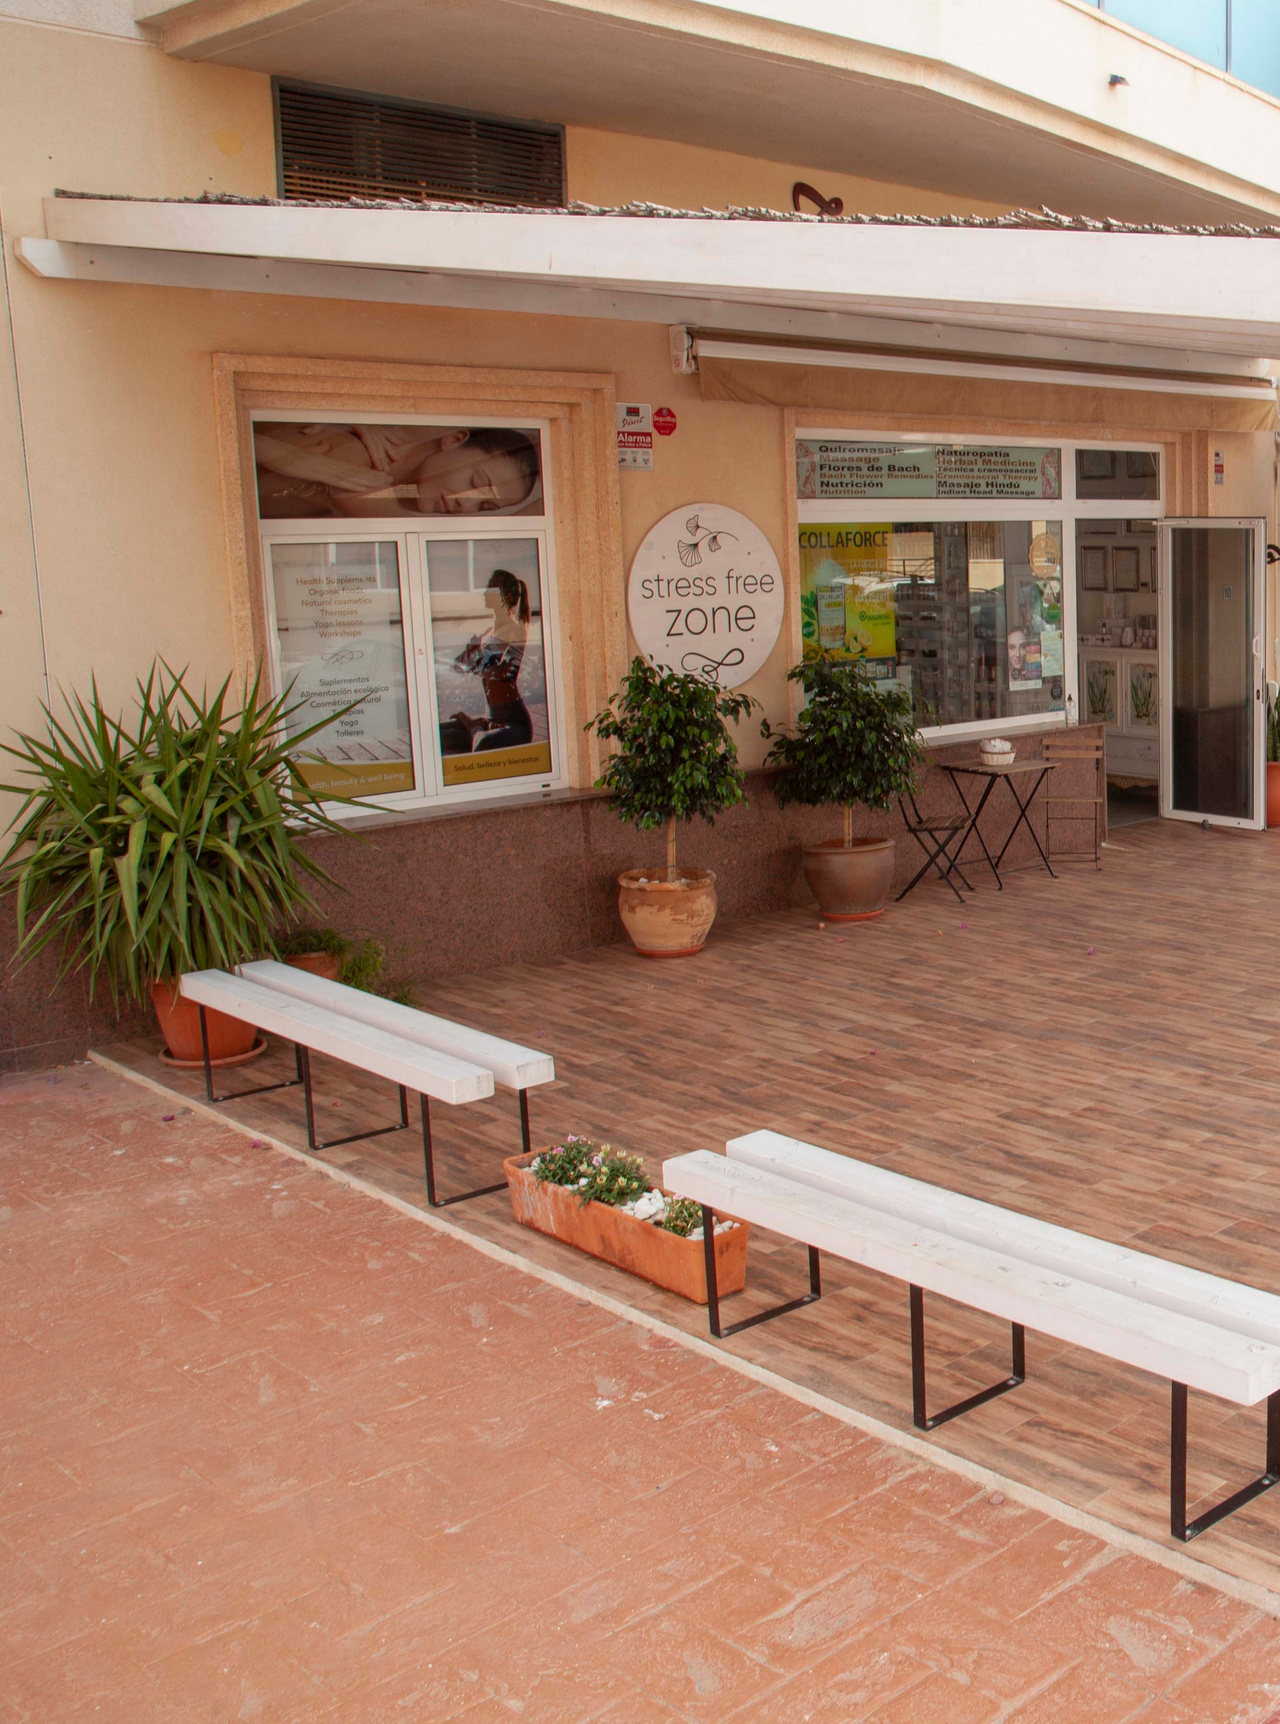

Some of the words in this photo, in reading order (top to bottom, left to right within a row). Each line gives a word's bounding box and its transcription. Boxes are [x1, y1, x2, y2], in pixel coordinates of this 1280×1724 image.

[618, 432, 652, 443] Alarma
[818, 445, 904, 456] Quiromasaje
[820, 455, 880, 465] Massage
[937, 457, 978, 466] Herbal
[982, 459, 1036, 467] Medicine
[820, 464, 862, 472] Flores
[867, 464, 883, 472] de
[1002, 473, 1038, 481] Therapy
[820, 480, 884, 488] Nutrición
[938, 481, 981, 490] Masaje
[985, 481, 1020, 489] Hindú
[799, 531, 889, 550] COLLAFORCE
[296, 577, 324, 586] Health
[326, 576, 376, 586] Supplements
[642, 574, 717, 599] stress
[725, 568, 774, 595] free
[309, 588, 339, 598] Organic
[302, 599, 332, 608] Natural
[334, 597, 372, 606] cosmetics
[320, 608, 358, 618] Therapies
[314, 620, 334, 629] Yoga
[335, 618, 363, 627] lessons
[665, 605, 756, 637] zone
[318, 630, 361, 638] Workshops
[320, 676, 370, 687] Suplementos
[300, 688, 352, 699] Alimentación
[354, 685, 389, 695] ecológica
[310, 698, 352, 708] Cosmética
[339, 718, 359, 728] Yoga
[335, 728, 364, 738] Talleres
[477, 761, 501, 770] belleza
[508, 756, 540, 766] bienestar
[331, 778, 358, 788] beauty
[367, 774, 382, 782] well
[384, 772, 404, 780] being
